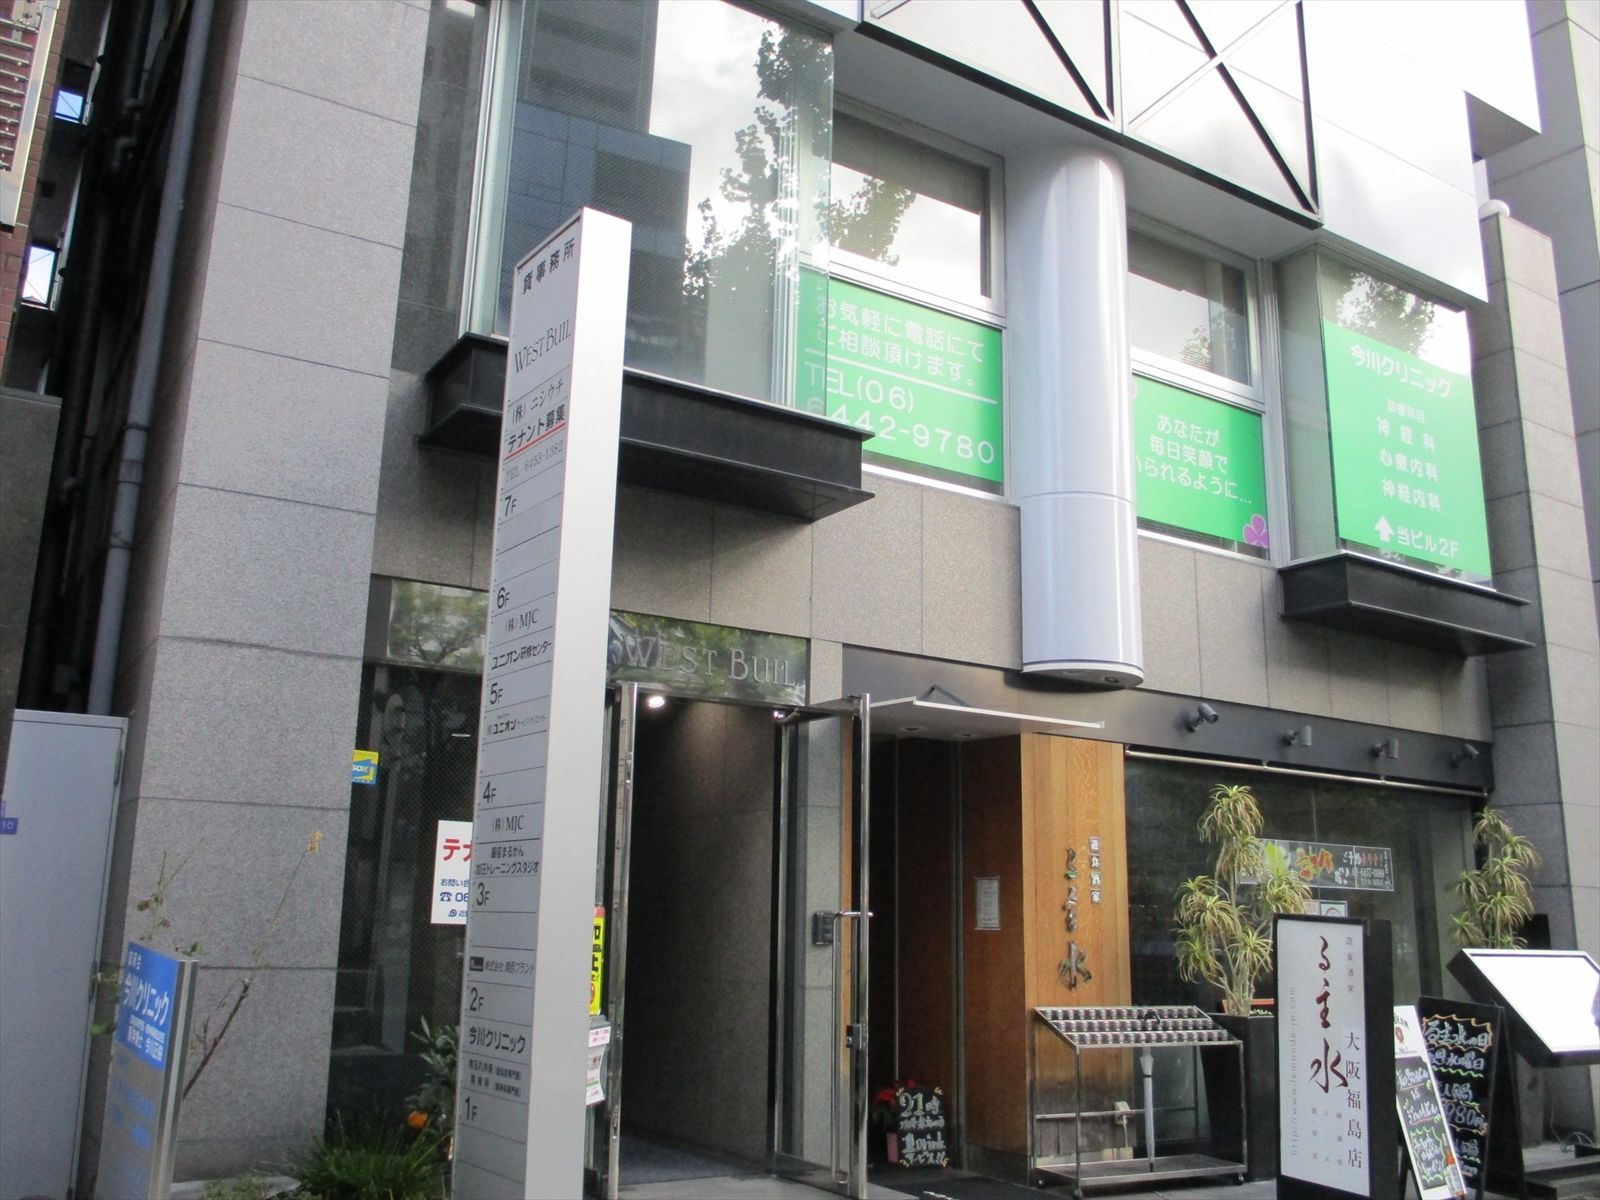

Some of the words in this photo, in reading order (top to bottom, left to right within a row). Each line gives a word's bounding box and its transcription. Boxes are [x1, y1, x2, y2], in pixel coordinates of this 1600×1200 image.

[523, 237, 576, 295] 貸事務所
[817, 297, 984, 362] お気軽に電話にて
[514, 337, 545, 373] WEST
[817, 319, 974, 387] ご相談頂けます。
[1350, 344, 1451, 397] 今川クリニック
[1387, 399, 1427, 424] 診療科目
[509, 404, 566, 454] テナント募集
[1156, 413, 1220, 448] あなたが
[1149, 433, 1229, 475] 毎日笑顔で
[1379, 448, 1438, 483] 心療内科
[505, 495, 518, 517] 7F
[1382, 479, 1441, 513] 神経内科
[1396, 525, 1460, 559] 当ビル2F
[497, 586, 511, 610] 6F
[520, 608, 540, 630] MJC
[622, 631, 718, 677] WEST
[490, 682, 504, 705] 5F
[483, 781, 497, 804] 4F
[506, 814, 526, 834] MJC
[477, 882, 490, 906] 3F
[123, 974, 170, 1026] 今川クリニック
[471, 987, 485, 1012] 2F
[470, 1026, 527, 1055] 今川クリニック
[466, 1096, 478, 1121] 1F
[1344, 1031, 1363, 1169] 大阪福島店
